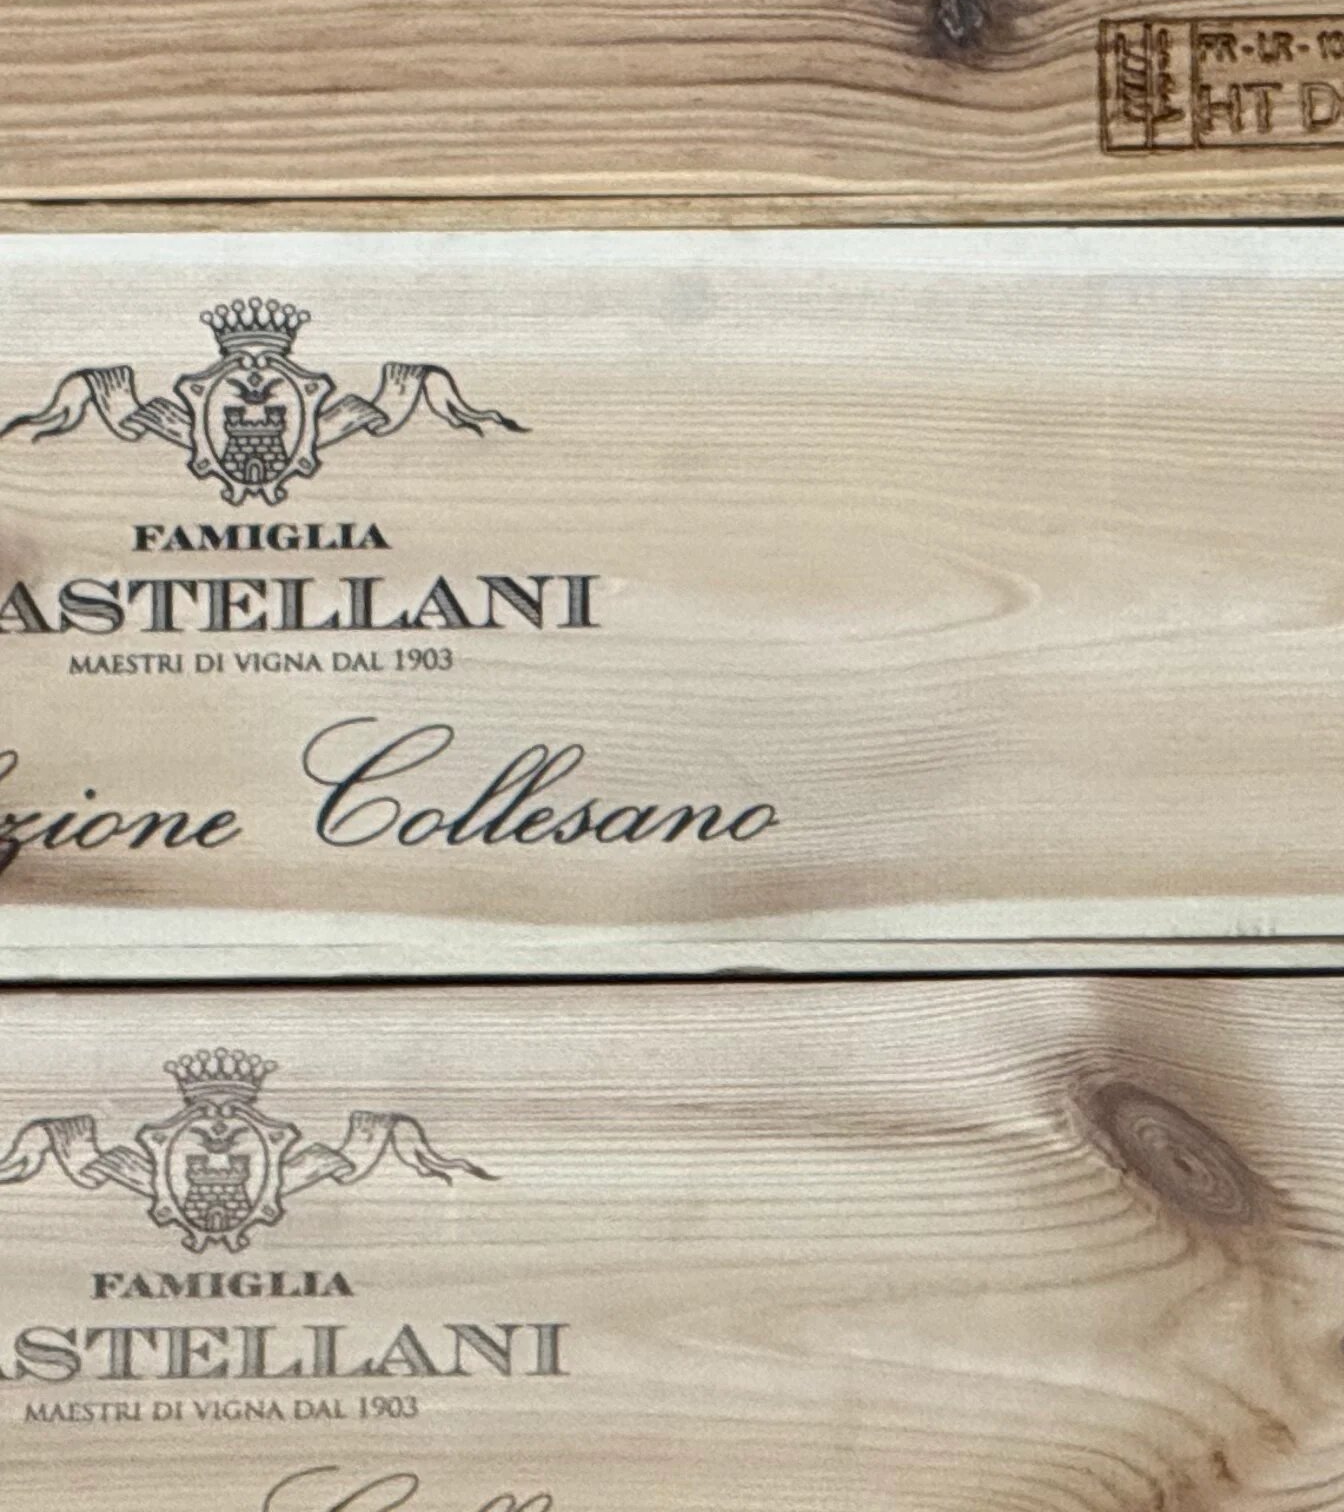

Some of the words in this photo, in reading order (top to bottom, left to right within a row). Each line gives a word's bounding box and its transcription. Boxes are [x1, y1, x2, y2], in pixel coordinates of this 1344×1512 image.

[1199, 81, 1283, 134] HT
[131, 522, 394, 553] FAMIGLIA
[0, 573, 602, 636] ASTELLANI
[68, 652, 184, 676] MAESTRI
[196, 652, 225, 675] DI
[233, 651, 323, 675] VIGNA
[331, 650, 385, 674] DAL
[395, 647, 455, 673] 1903
[303, 716, 781, 847] Collesano
[90, 1270, 356, 1301] FAMIGLIA
[0, 1322, 572, 1382] STELLANI
[23, 1398, 145, 1423] MAESTRI
[152, 1398, 184, 1421] DI
[192, 1399, 285, 1421] VIGNA
[293, 1398, 346, 1420] DAL
[358, 1395, 420, 1419] 1903
